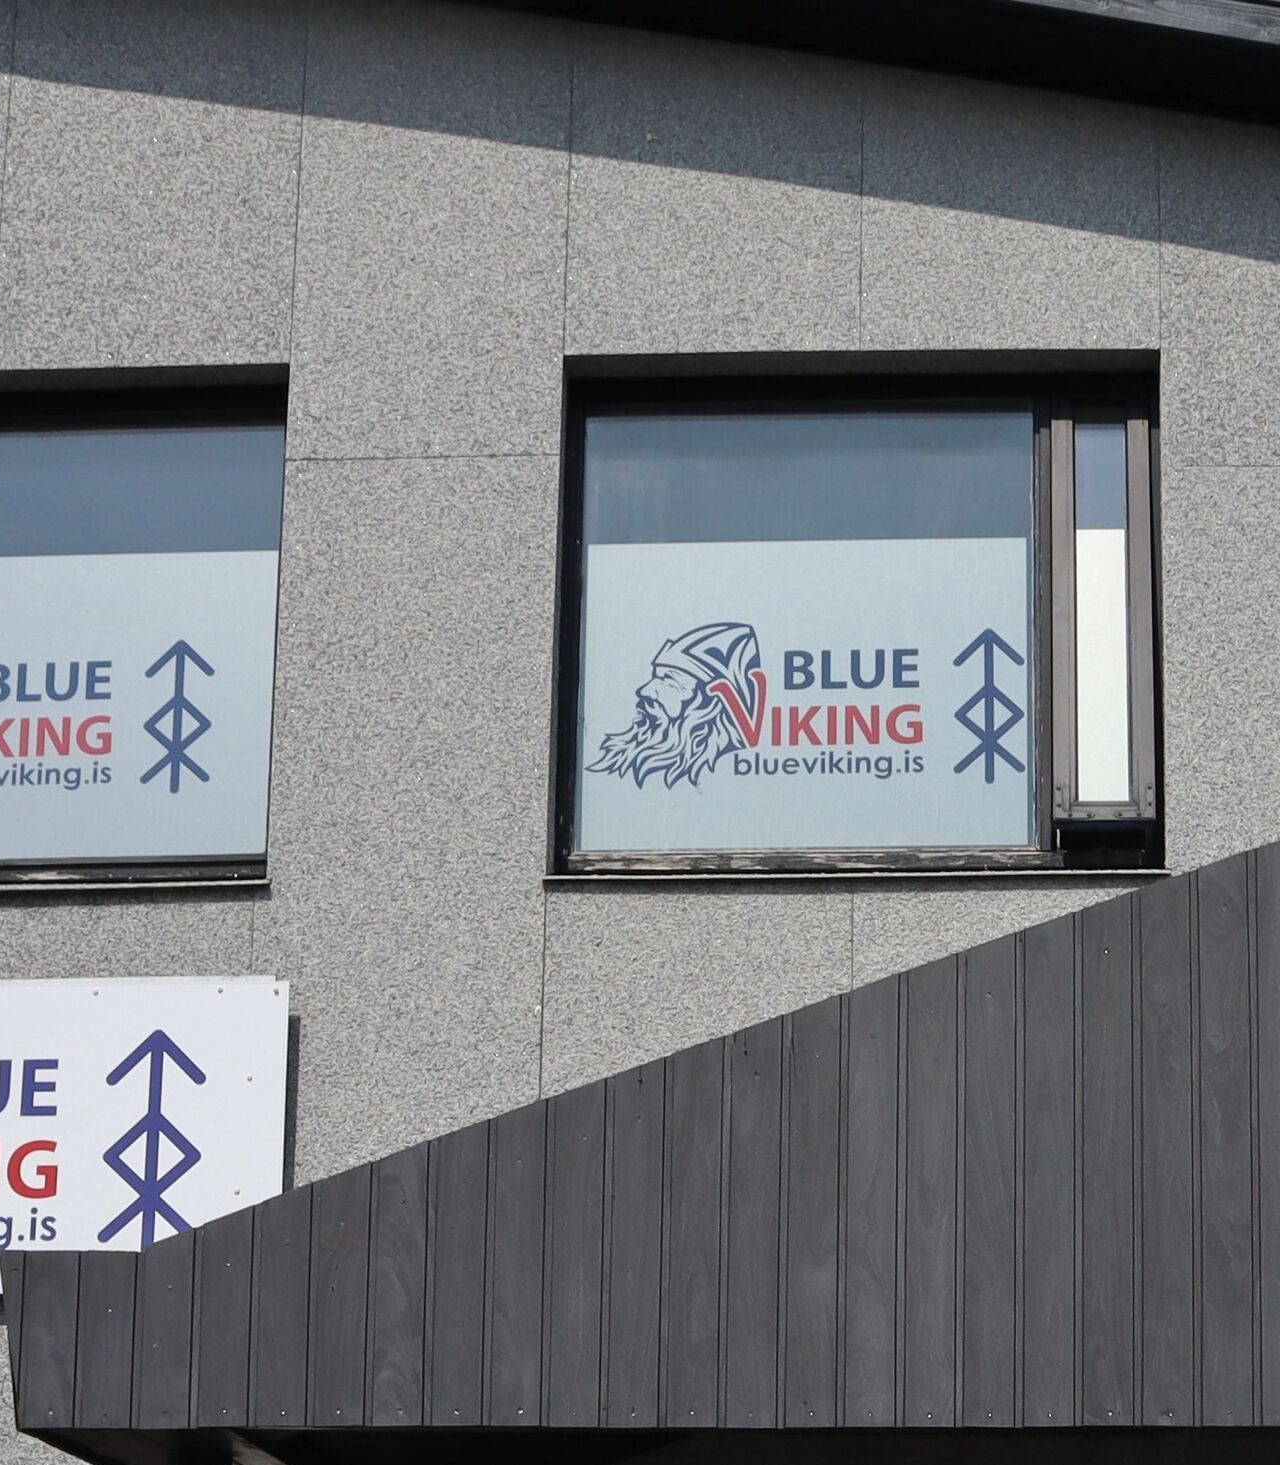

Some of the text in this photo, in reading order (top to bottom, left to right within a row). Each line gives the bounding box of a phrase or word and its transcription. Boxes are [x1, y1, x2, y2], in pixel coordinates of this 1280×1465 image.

[782, 648, 921, 691] BLUE
[710, 668, 924, 748] VIKING
[732, 750, 925, 780] blueviking.is
